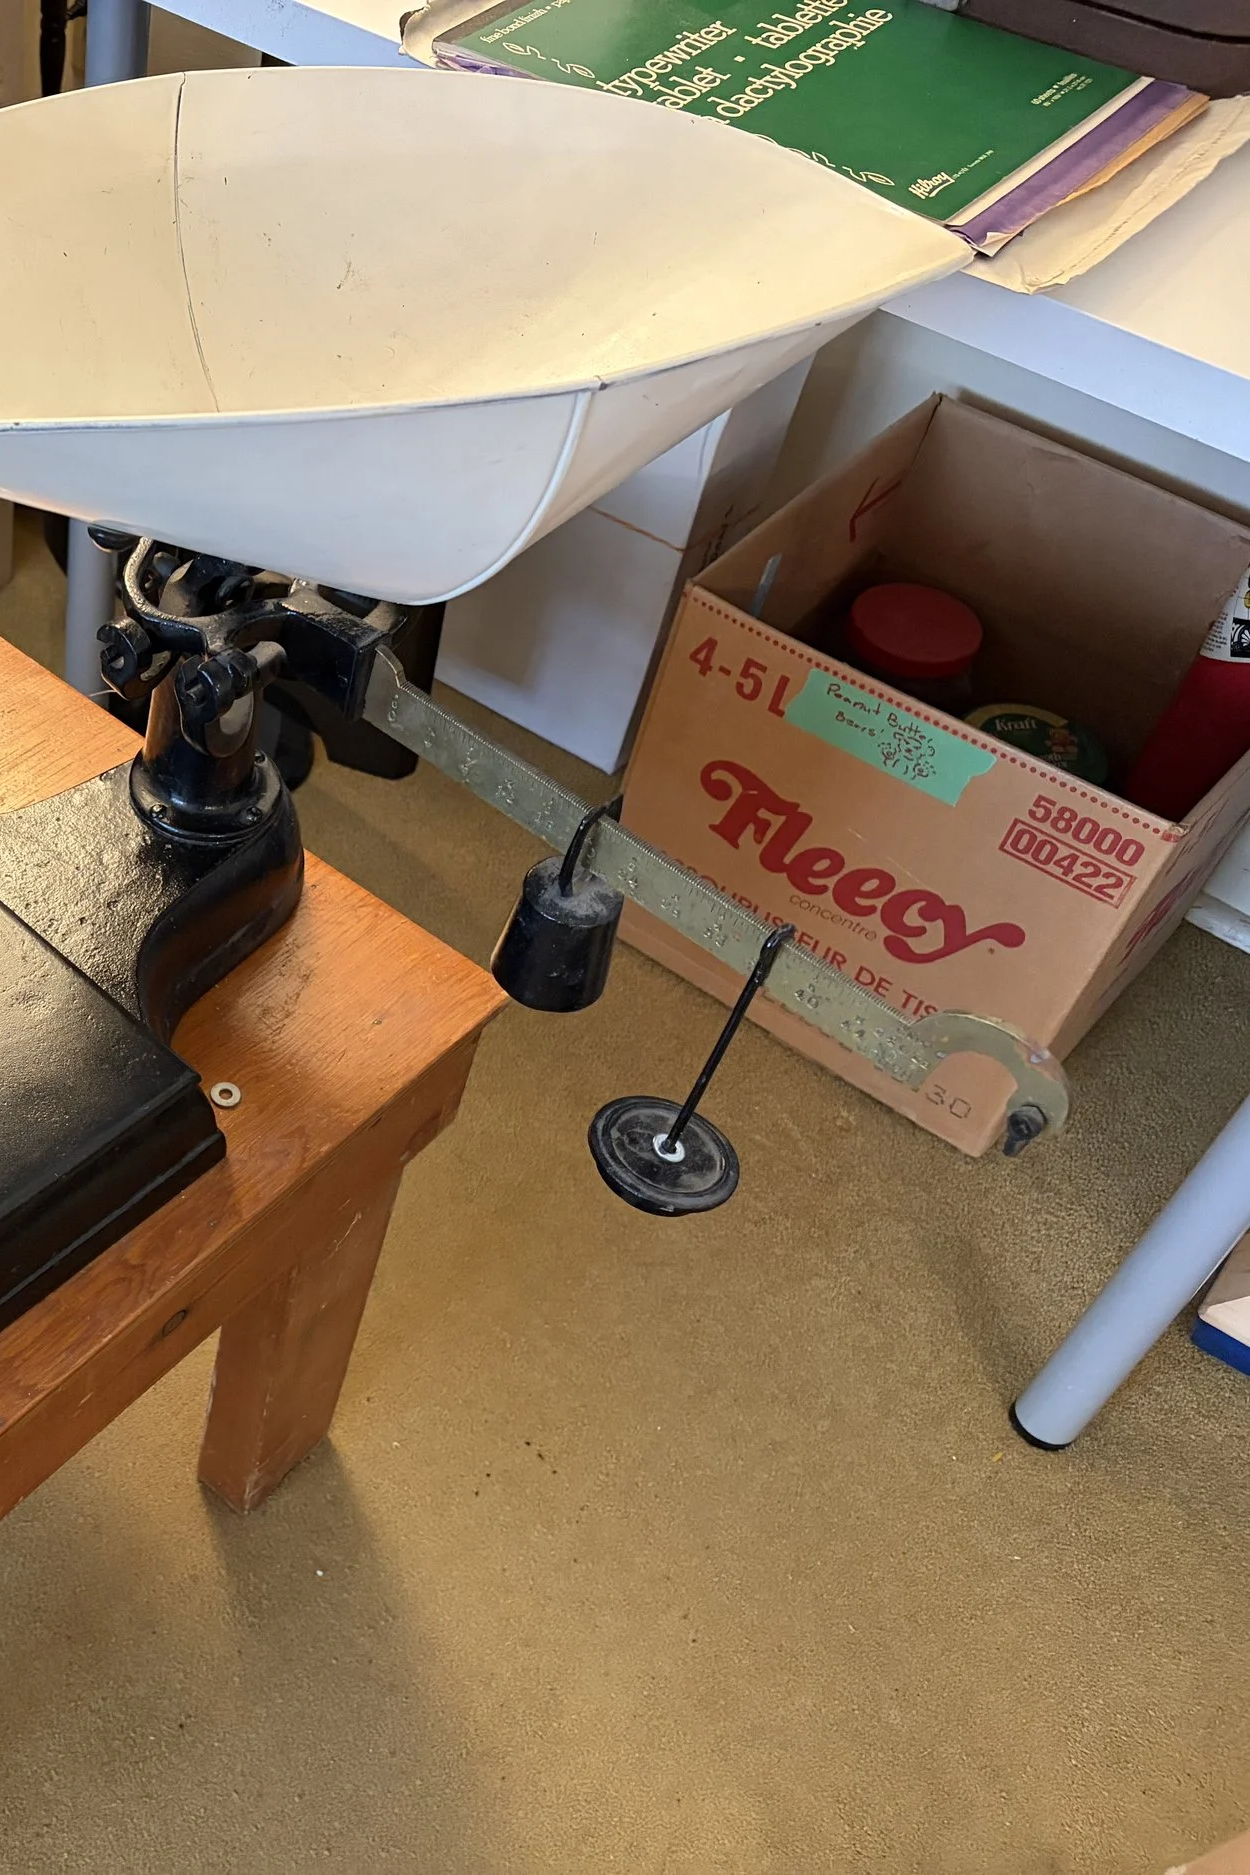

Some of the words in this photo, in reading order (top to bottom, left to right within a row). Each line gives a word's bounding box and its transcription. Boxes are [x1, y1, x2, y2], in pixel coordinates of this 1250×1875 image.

[596, 20, 738, 97] typewriter
[651, 65, 732, 110] ablet
[706, 8, 893, 118] dactylographie
[908, 171, 955, 200] Hilroy
[994, 717, 1039, 732] Kraft
[1027, 794, 1146, 867] 58000
[700, 760, 1026, 964] Fleecy
[1009, 828, 1125, 901] 00422
[853, 965, 894, 999] DE
[925, 1083, 973, 1120] 30
